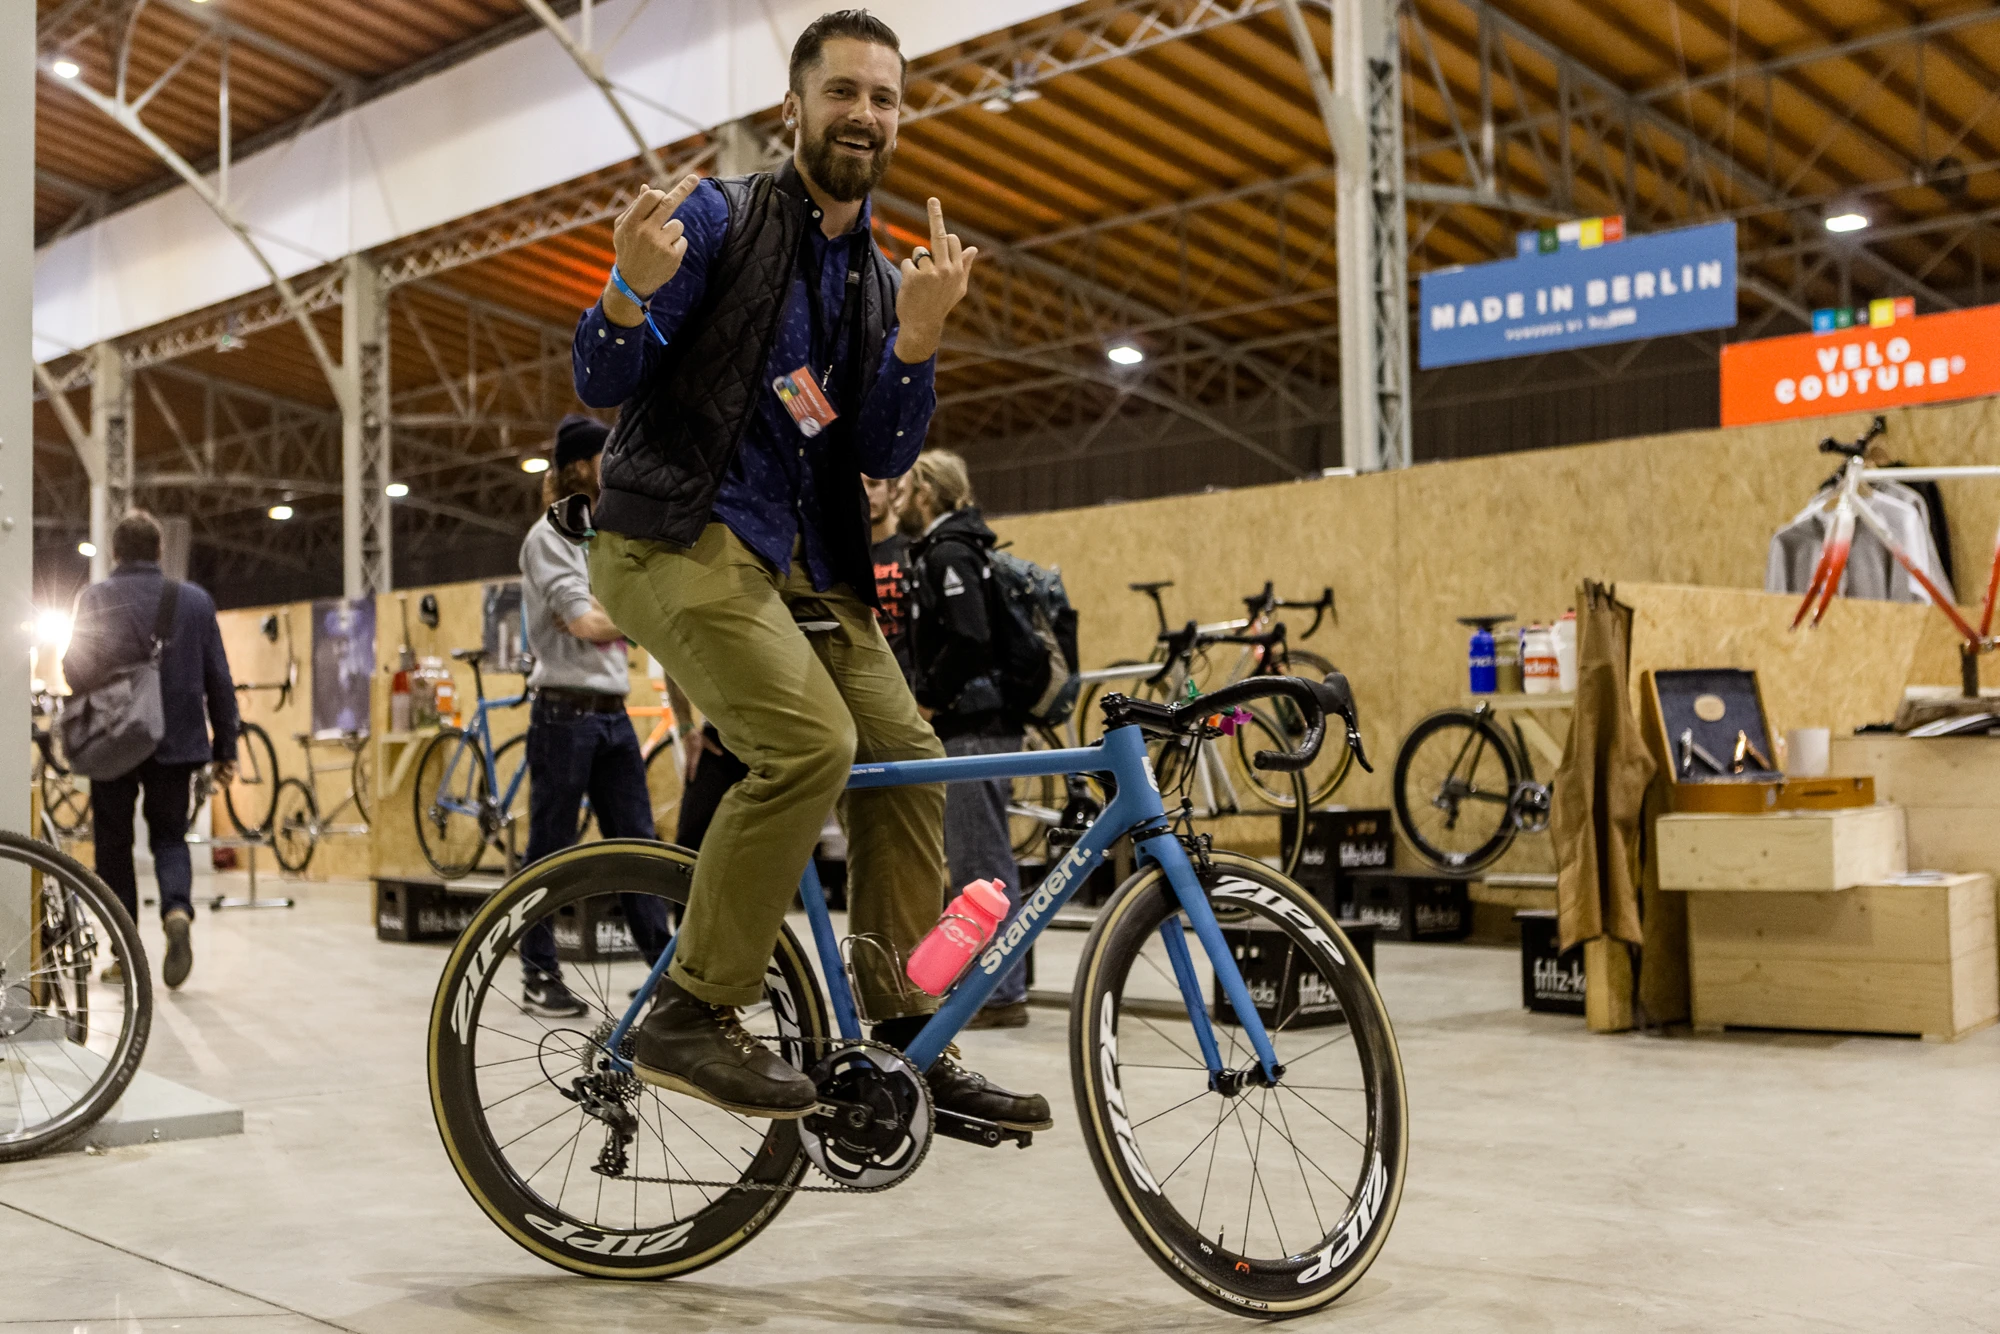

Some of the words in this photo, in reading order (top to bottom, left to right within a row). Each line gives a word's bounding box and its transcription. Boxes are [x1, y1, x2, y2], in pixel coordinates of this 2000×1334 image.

[1431, 293, 1525, 330] MADE
[1537, 284, 1573, 316] IN
[1586, 260, 1721, 308] BERLIN
[1817, 337, 1910, 373] VELO
[450, 887, 548, 1045] ZIPP
[1210, 875, 1346, 966] ZIPP
[1100, 990, 1162, 1196] ZIPP
[524, 1213, 695, 1257] ZIPP
[1296, 1150, 1389, 1284] ZIPP
